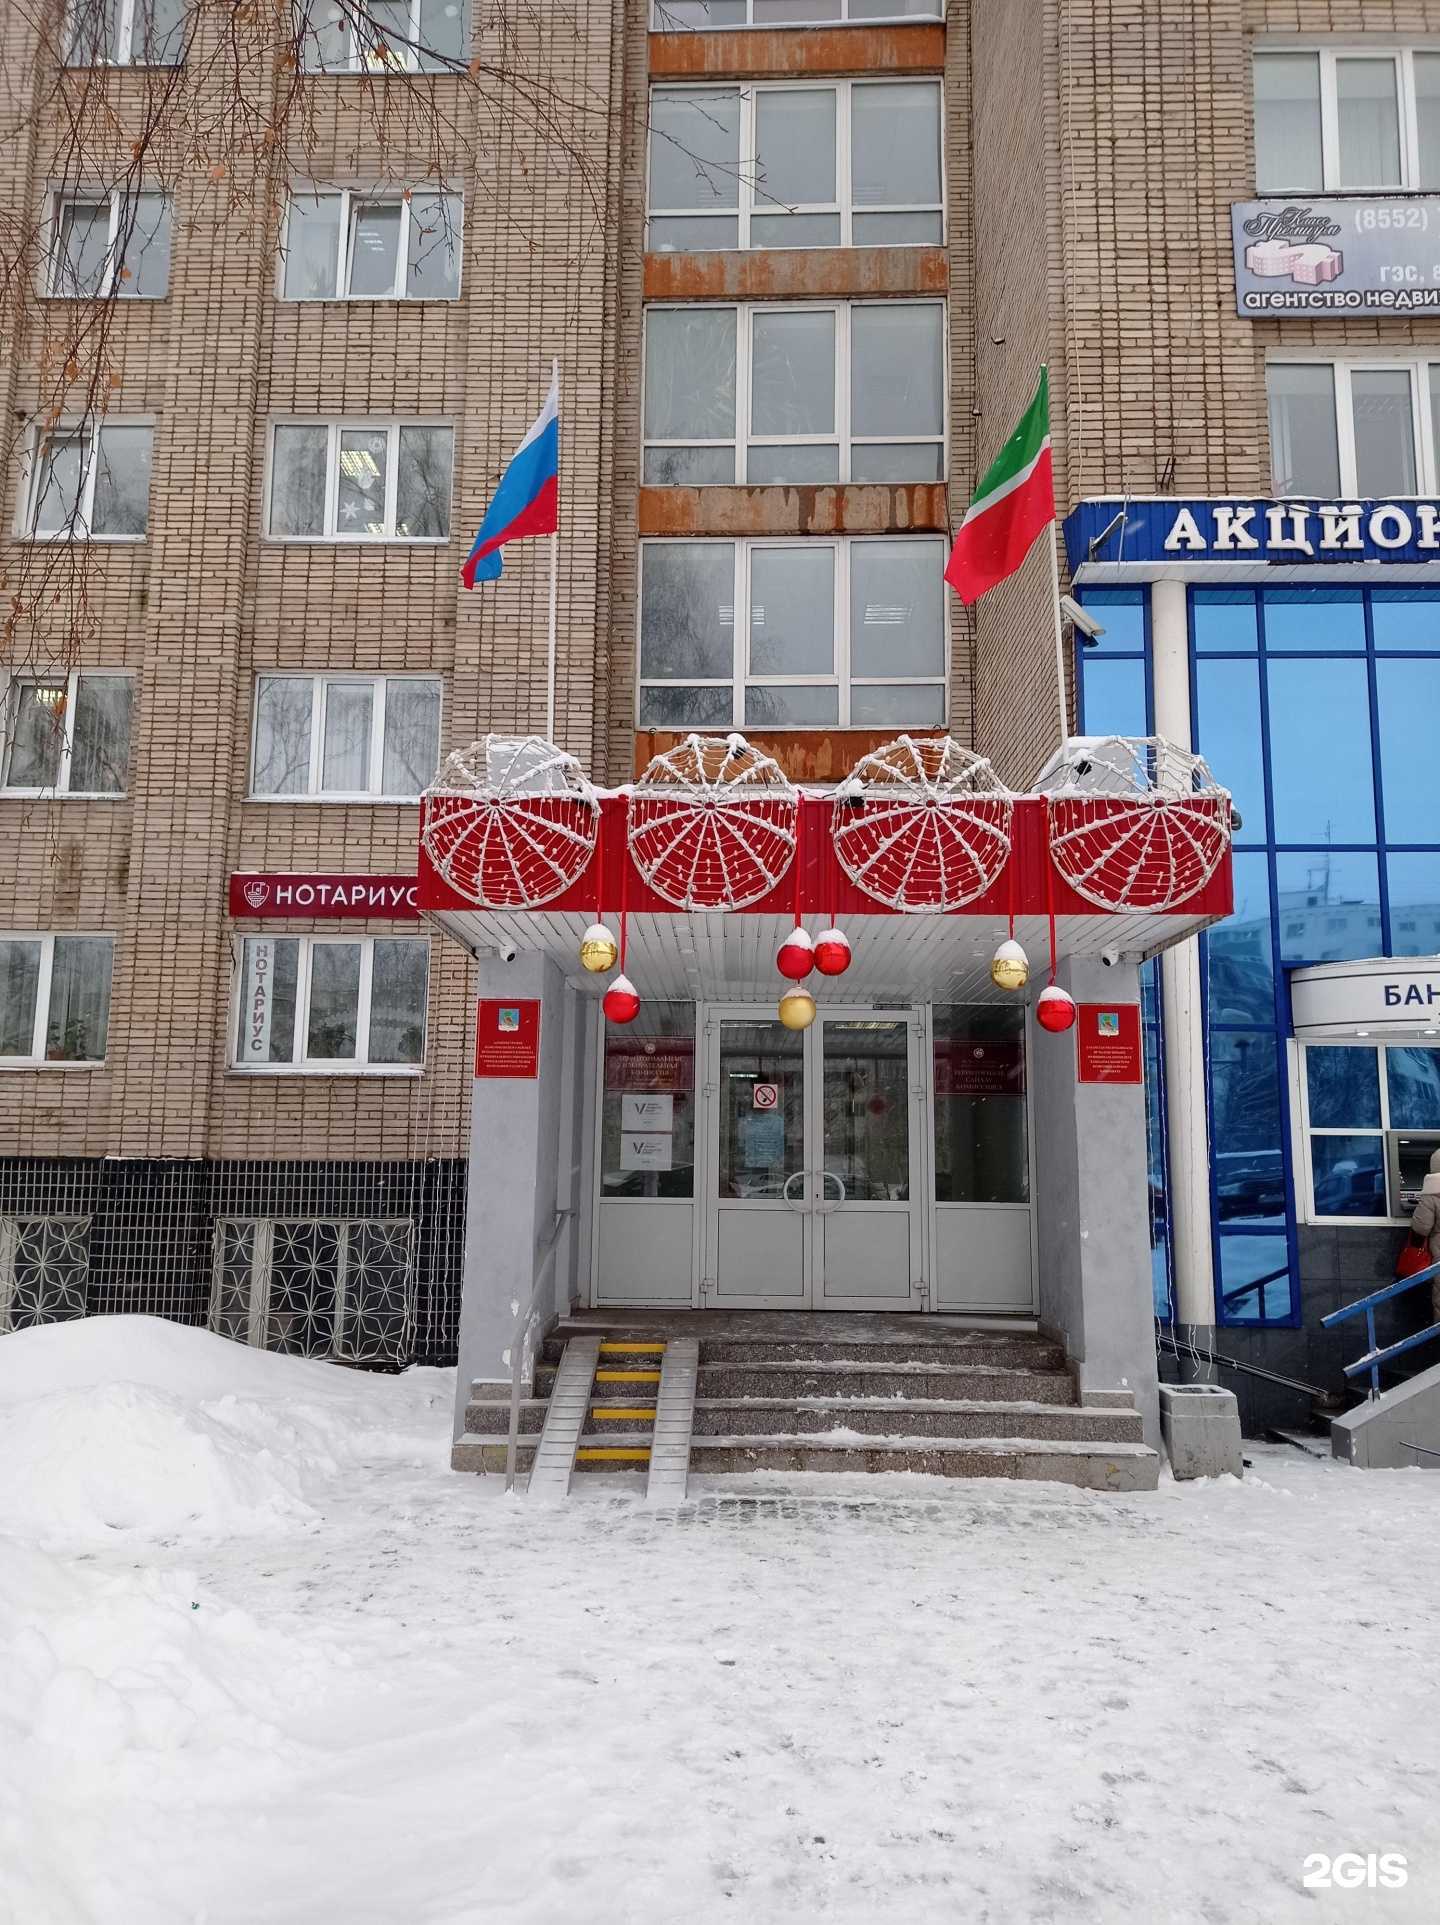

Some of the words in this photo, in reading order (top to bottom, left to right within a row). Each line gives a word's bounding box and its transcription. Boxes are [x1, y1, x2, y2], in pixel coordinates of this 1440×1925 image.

[1355, 207, 1428, 233] (8552)
[1245, 291, 1361, 308] агентство
[1365, 288, 1440, 309] недви
[276, 883, 418, 907] НОТАРИУС
[251, 944, 268, 1051] НОТАРИУС
